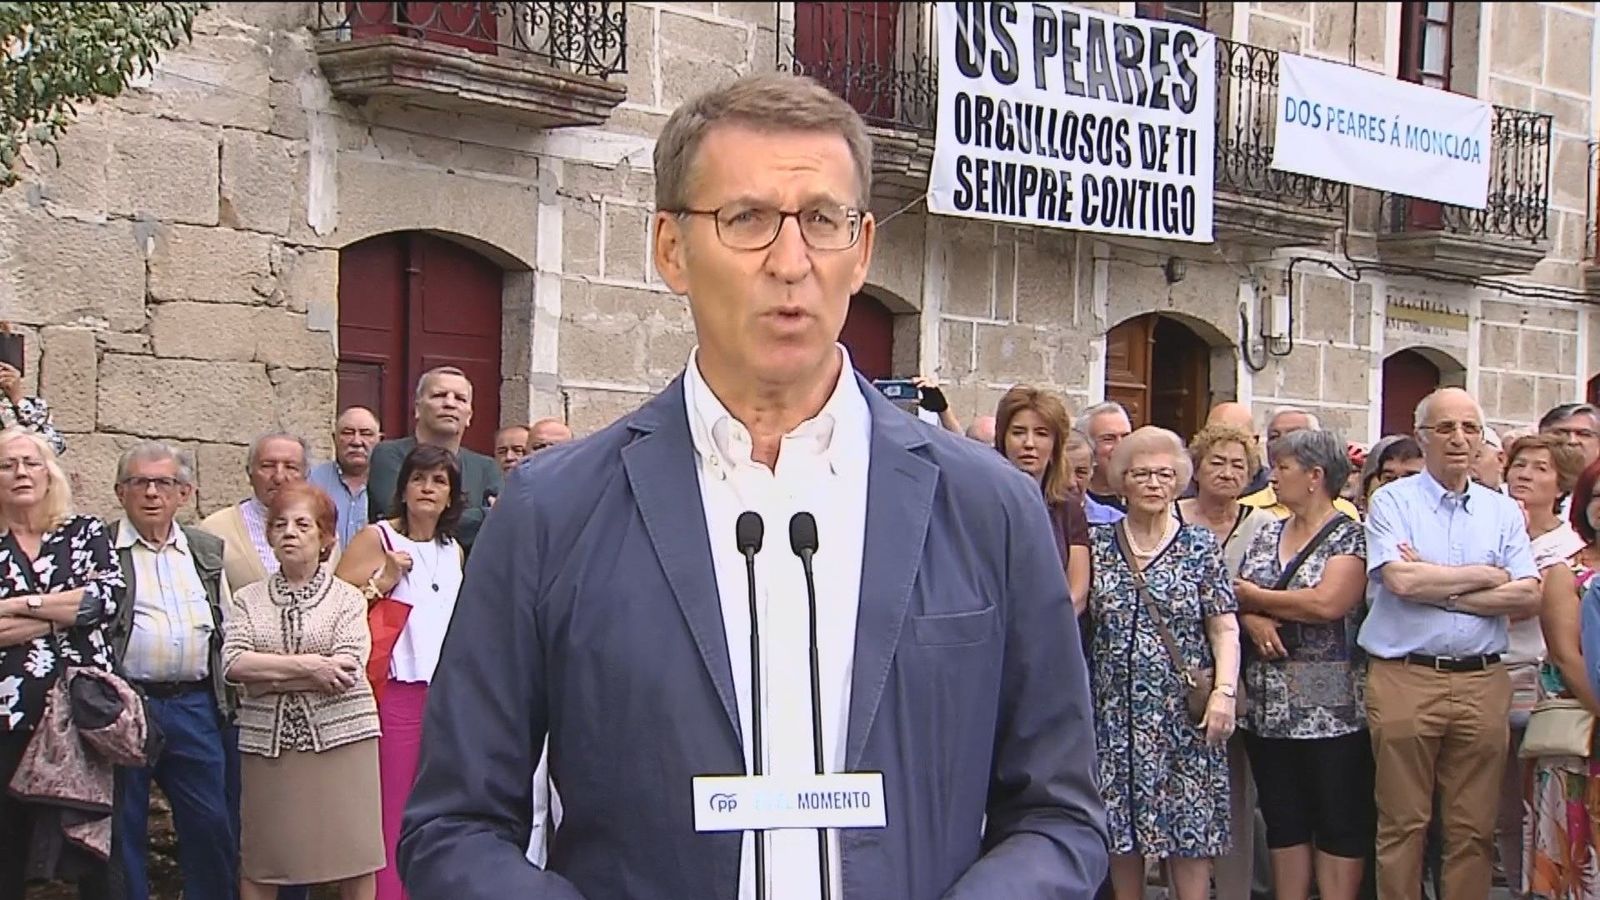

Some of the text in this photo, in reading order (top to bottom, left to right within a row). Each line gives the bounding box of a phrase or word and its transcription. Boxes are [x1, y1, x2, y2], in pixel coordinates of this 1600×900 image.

[1033, 3, 1199, 114] PEARES
[954, 92, 1196, 176] ORGULLOSOS DE TI
[1285, 97, 1481, 164] DOS PEARES Á MONCLOA
[953, 155, 1196, 236] SEMPRE CONTIGO
[797, 791, 871, 810] MOMENTO
